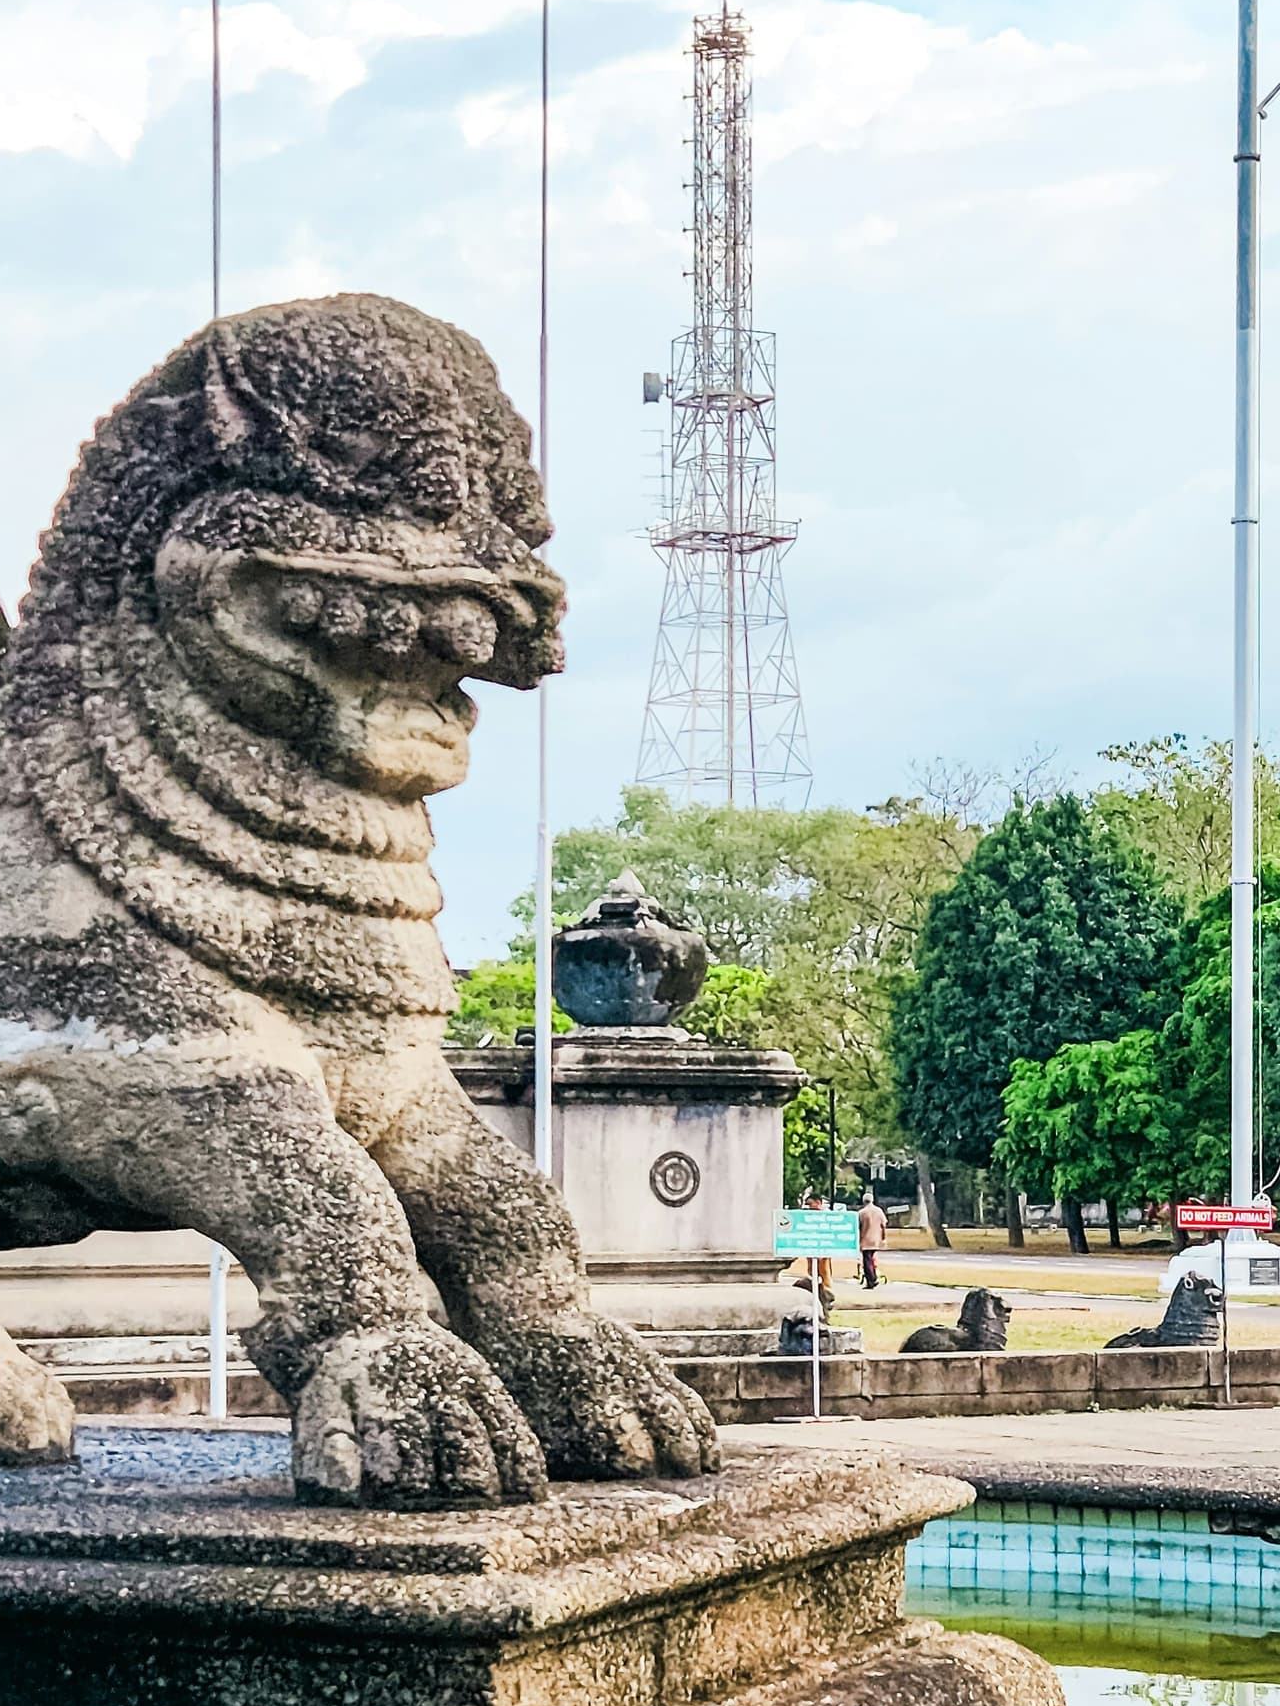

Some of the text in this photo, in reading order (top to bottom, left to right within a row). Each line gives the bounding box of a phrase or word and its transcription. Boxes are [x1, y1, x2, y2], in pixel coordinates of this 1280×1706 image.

[1181, 1210, 1269, 1223] DO NOT FEED ANIMALS
